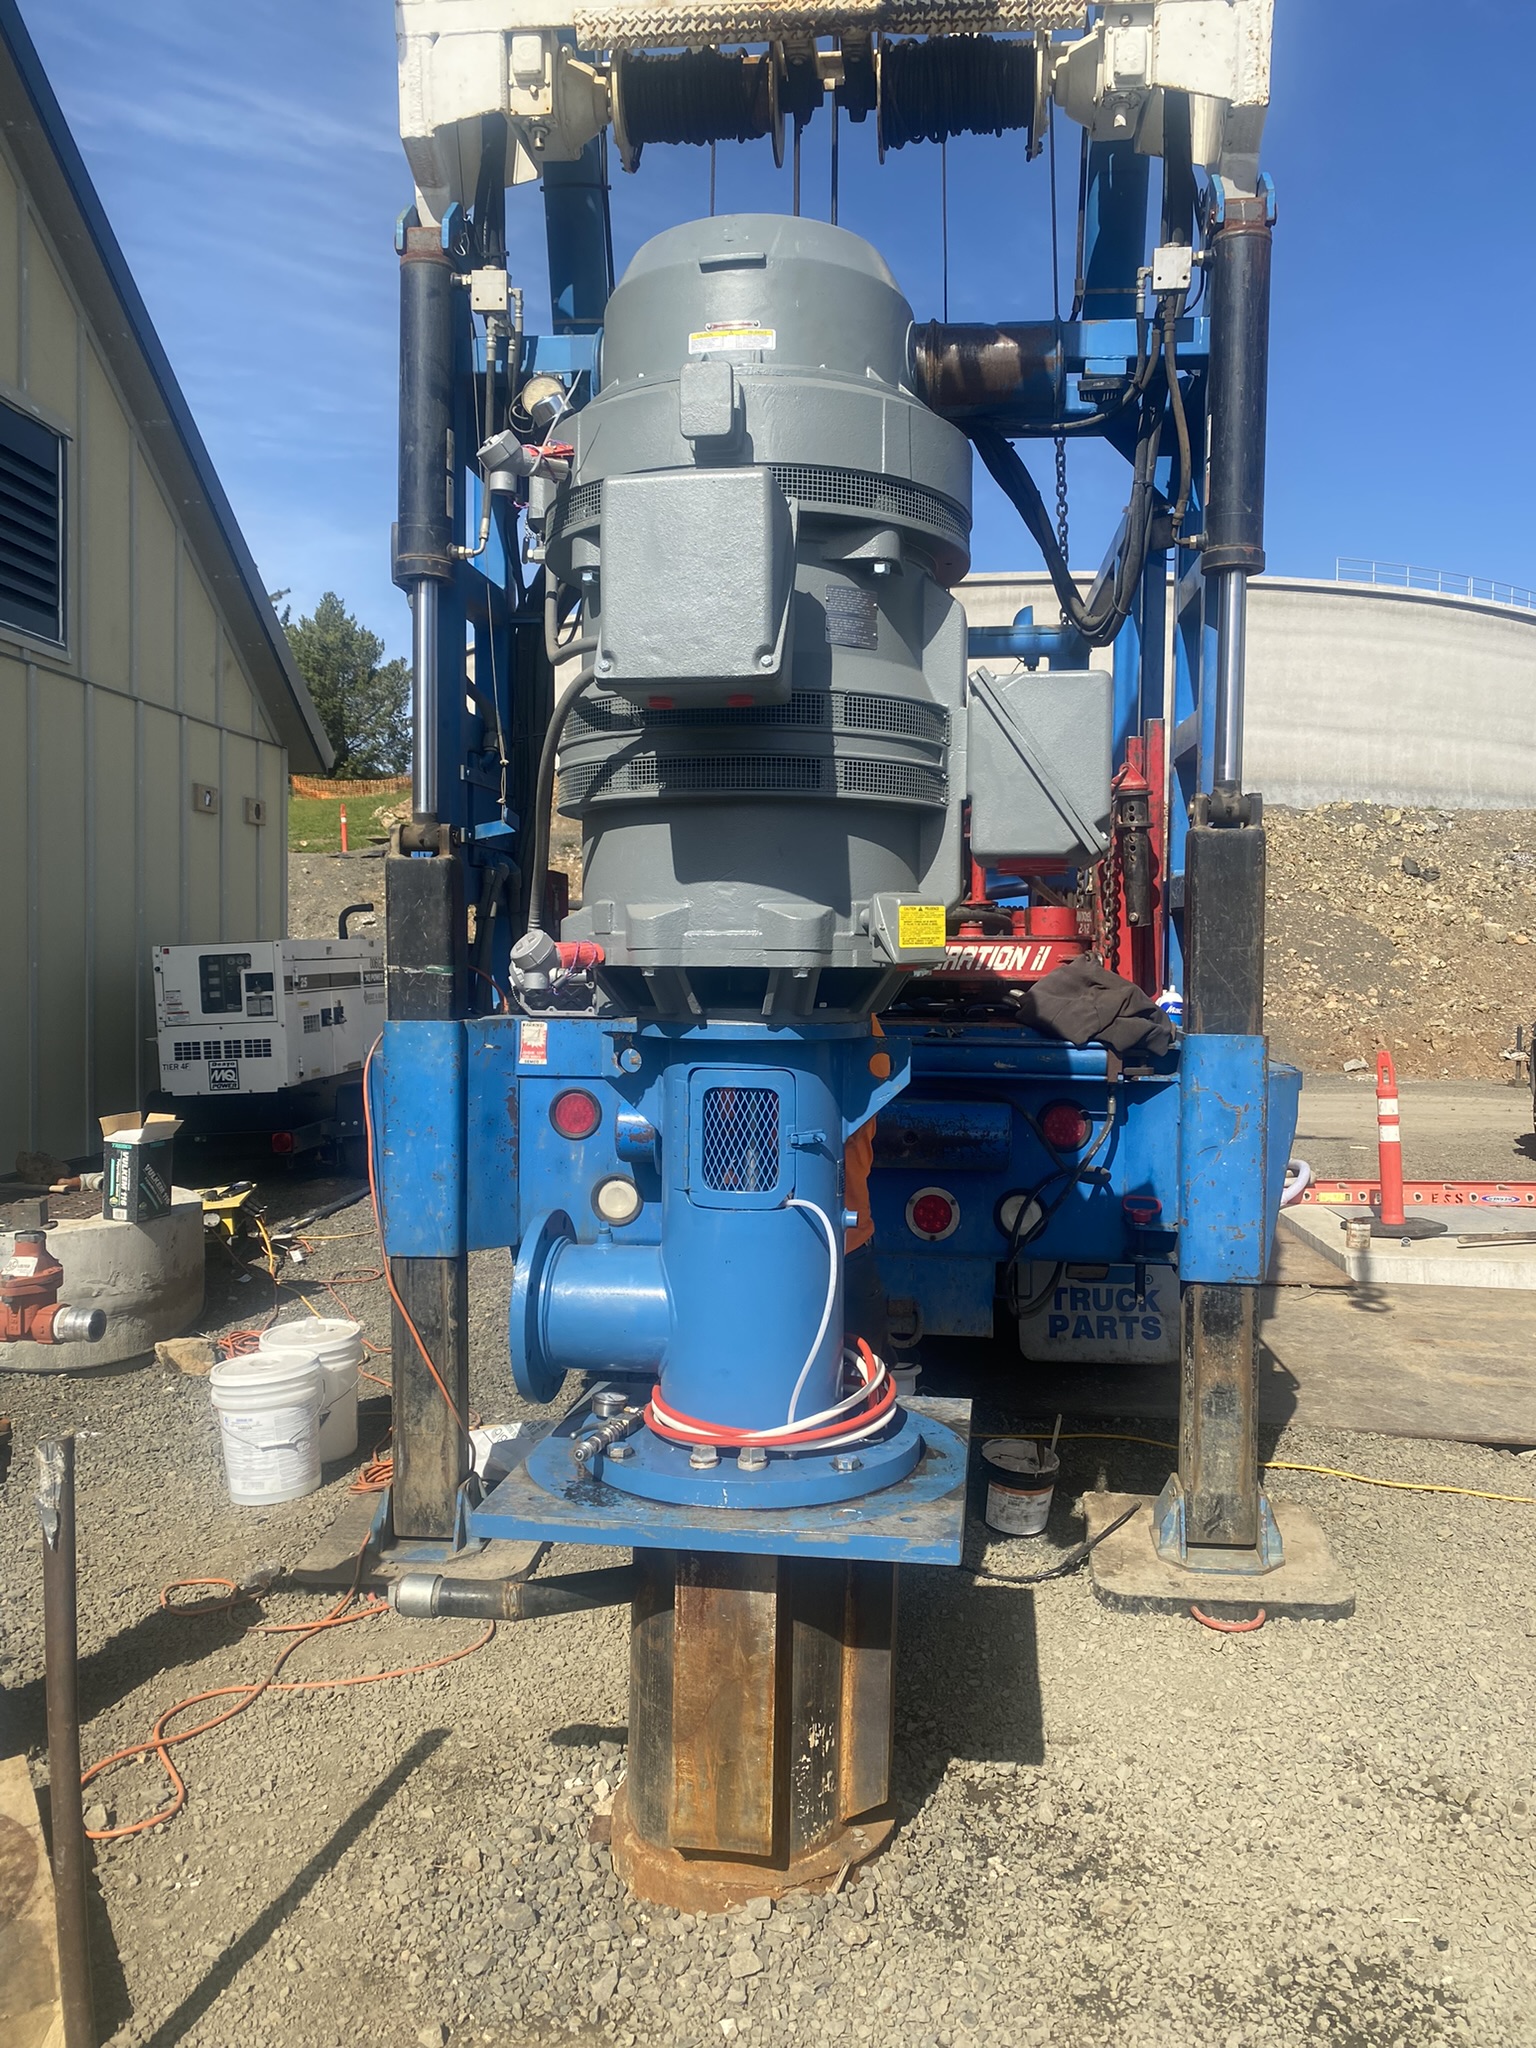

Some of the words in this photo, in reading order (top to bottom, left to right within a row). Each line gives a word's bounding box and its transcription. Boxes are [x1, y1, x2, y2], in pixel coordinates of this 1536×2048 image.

[162, 1063, 180, 1071] TIER
[211, 1069, 238, 1082] MQ
[120, 1151, 130, 1190] VULKEM
[144, 1163, 165, 1193] VULKEM
[1054, 1287, 1161, 1312] TRUCK
[1048, 1314, 1162, 1340] PARTS
